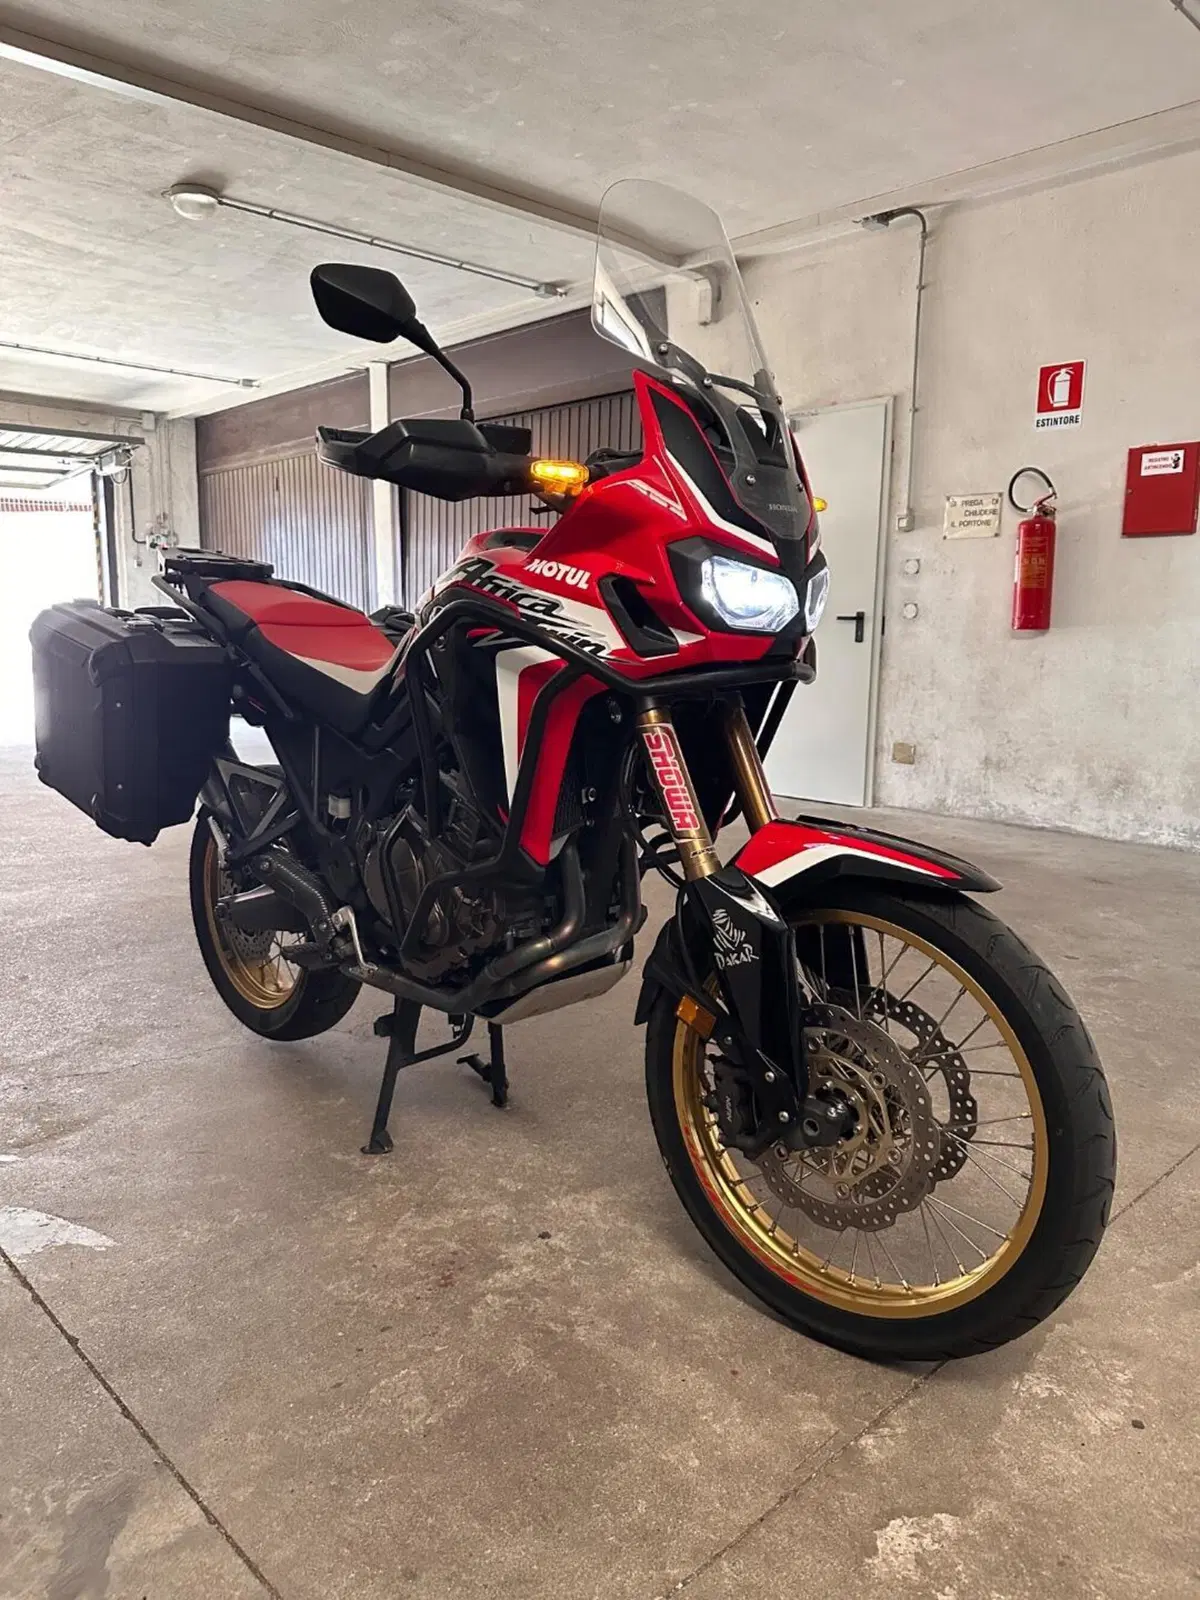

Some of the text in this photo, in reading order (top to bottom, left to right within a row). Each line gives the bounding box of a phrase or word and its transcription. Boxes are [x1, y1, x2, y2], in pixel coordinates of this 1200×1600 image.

[1036, 414, 1080, 428] ESTINTORE
[768, 503, 799, 513] HONDA
[449, 555, 566, 619] Africa
[523, 557, 592, 591] MOTUL
[642, 732, 700, 832] SHOWA
[713, 943, 760, 970] DAKAR
